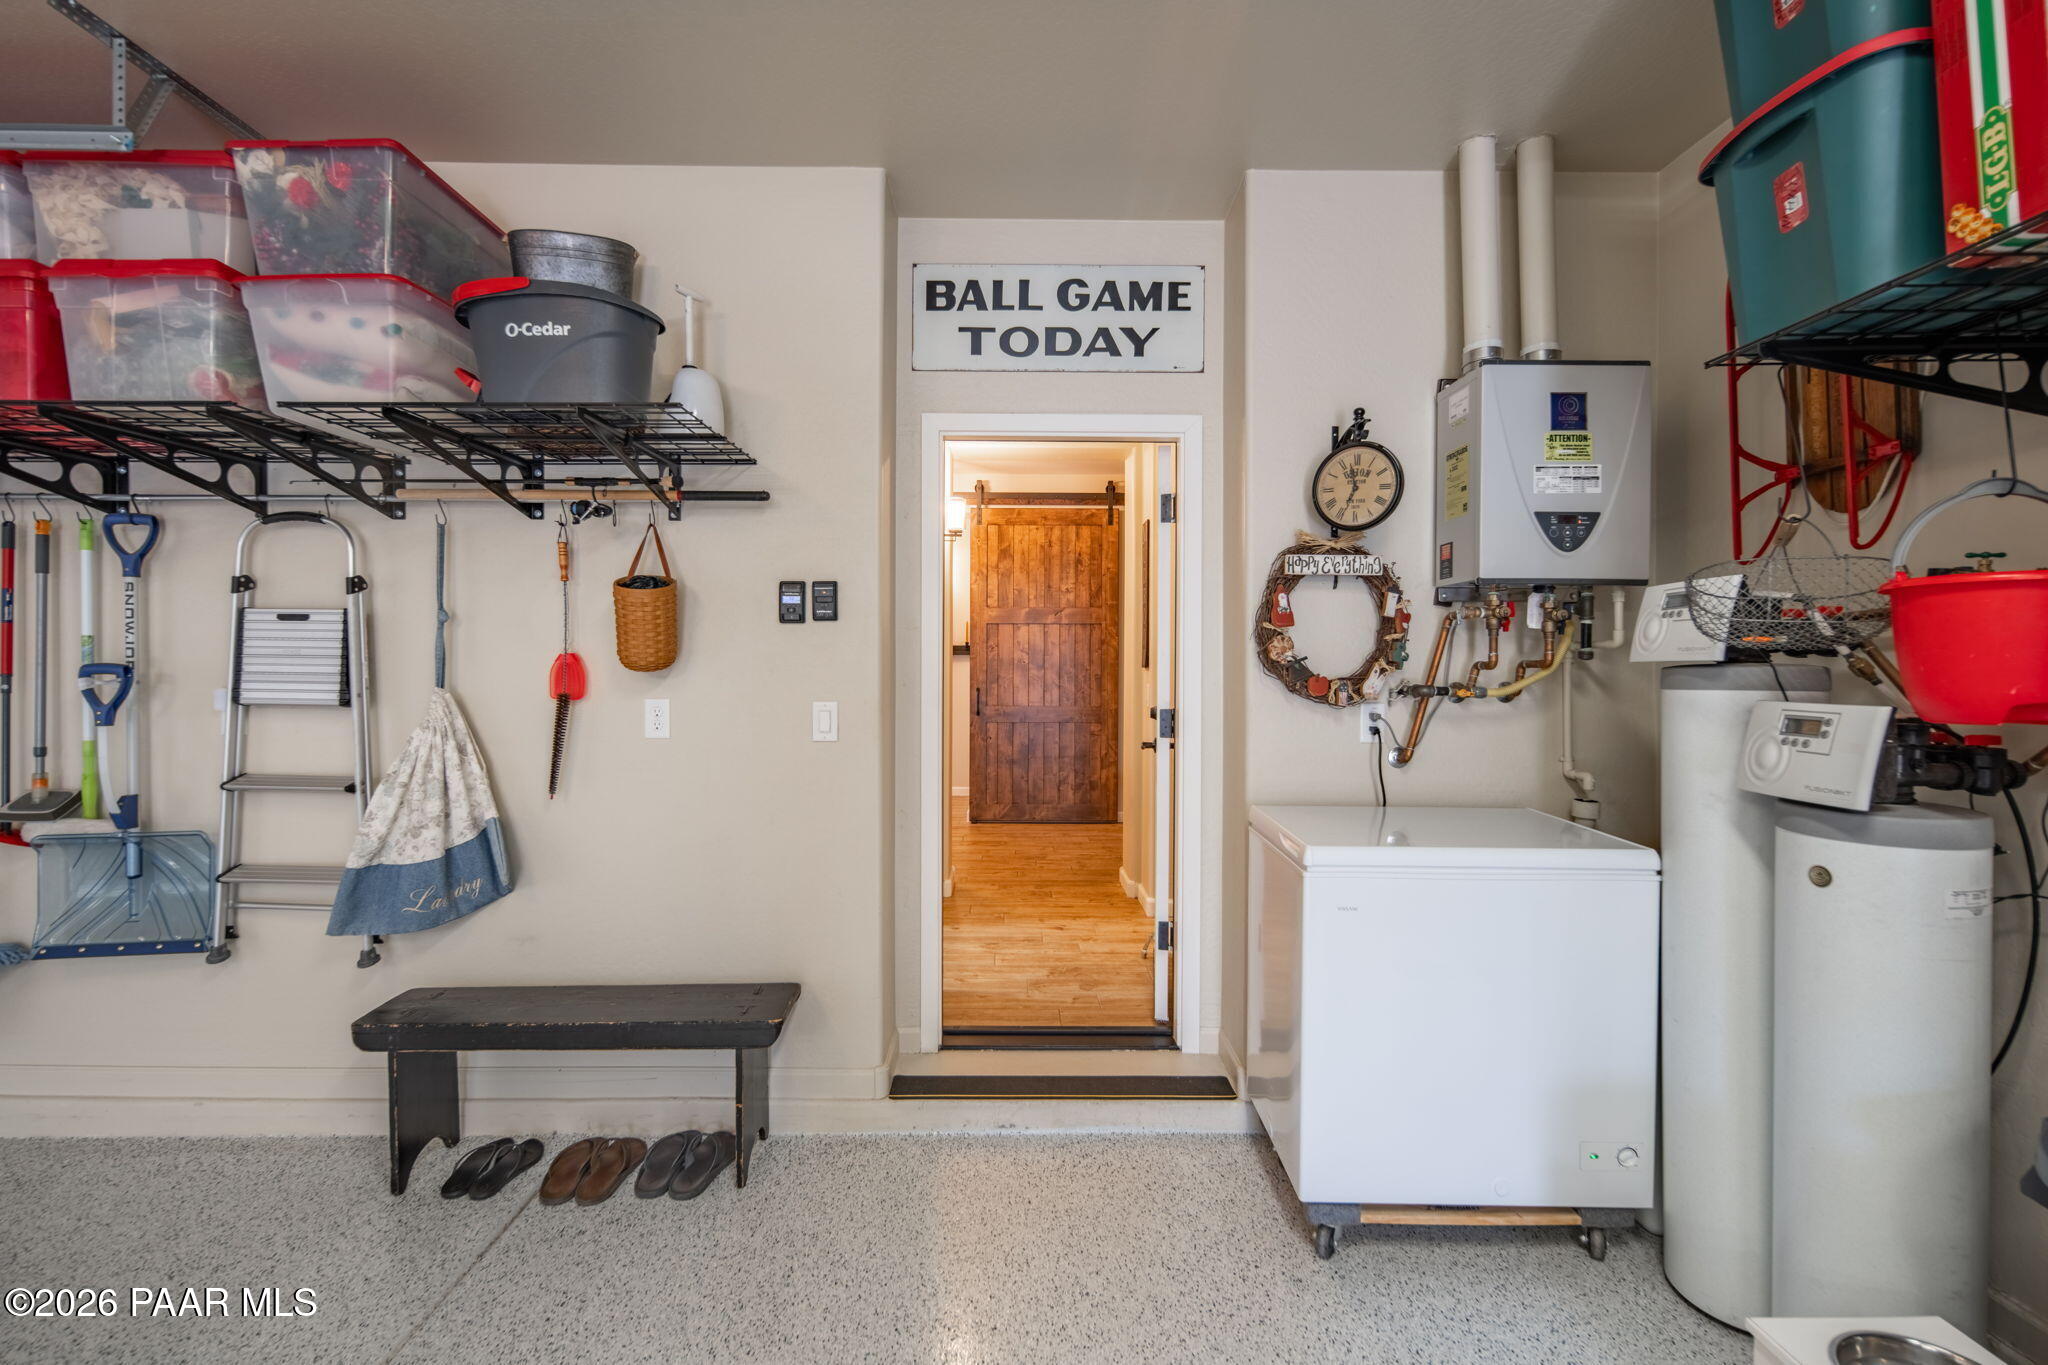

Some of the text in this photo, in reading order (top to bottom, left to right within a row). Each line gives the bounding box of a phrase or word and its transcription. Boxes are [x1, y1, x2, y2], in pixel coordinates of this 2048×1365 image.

[925, 278, 1192, 312] BALL GAME
[504, 321, 571, 338] O-Cedar
[958, 326, 1161, 358] TODAY
[1287, 556, 1320, 575] Happy
[401, 878, 482, 912] Ladry
